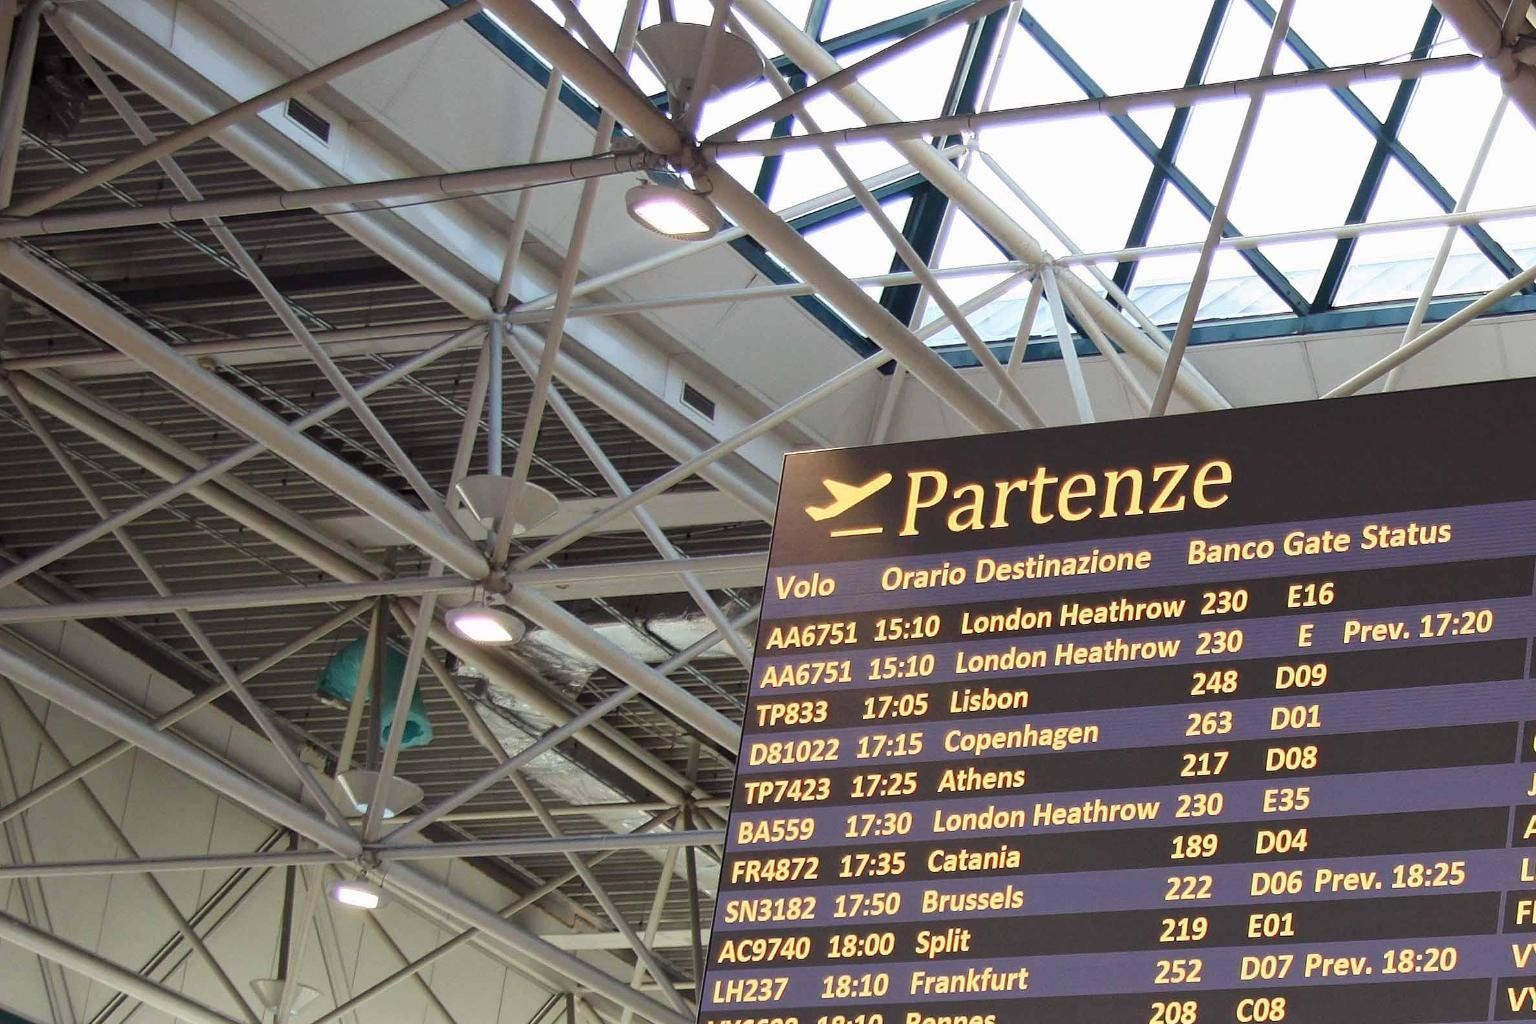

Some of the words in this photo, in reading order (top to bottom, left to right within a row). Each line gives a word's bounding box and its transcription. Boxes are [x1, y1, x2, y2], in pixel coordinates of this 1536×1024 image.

[897, 458, 1234, 538] Partenze
[773, 569, 840, 601] Volo
[878, 561, 968, 593] Orario
[973, 547, 1153, 585] Destinazione
[1186, 537, 1276, 566] Banco
[1281, 529, 1352, 558] Gate
[1359, 521, 1453, 551] Status
[764, 619, 859, 651] AA6751
[872, 613, 942, 643] 15:10
[960, 605, 1054, 636] London
[1058, 597, 1188, 628] Heathrow
[1199, 587, 1250, 617] 230
[1286, 580, 1336, 609] E16
[757, 658, 854, 690] AA6751
[867, 650, 937, 682] 15:10
[953, 644, 1049, 675] London
[1053, 636, 1182, 667] Heathrow
[1194, 627, 1245, 657] 230
[1296, 622, 1316, 649] E
[1342, 617, 1411, 645] Prev.
[1418, 608, 1496, 639] 17:20
[755, 698, 830, 728] TP833
[861, 691, 930, 721] 17:05
[948, 686, 1030, 715] Lisbon
[1189, 668, 1240, 697] 248
[1274, 662, 1329, 691] D09
[743, 776, 832, 806] TP7423
[849, 770, 919, 799] 17:25
[936, 765, 1027, 794] Athens
[1179, 750, 1231, 778] 217
[1264, 744, 1319, 773] D08
[730, 855, 821, 885] FR4872
[837, 850, 908, 879] 17:35
[926, 843, 1022, 874] Catania
[1169, 832, 1220, 861] 189
[1254, 827, 1309, 856] D04
[716, 935, 812, 965] AC9740
[826, 931, 897, 960] 18:00
[914, 926, 973, 960] Split
[1158, 915, 1210, 944] 219
[1246, 911, 1296, 939] E01
[1235, 995, 1287, 1024] C08
